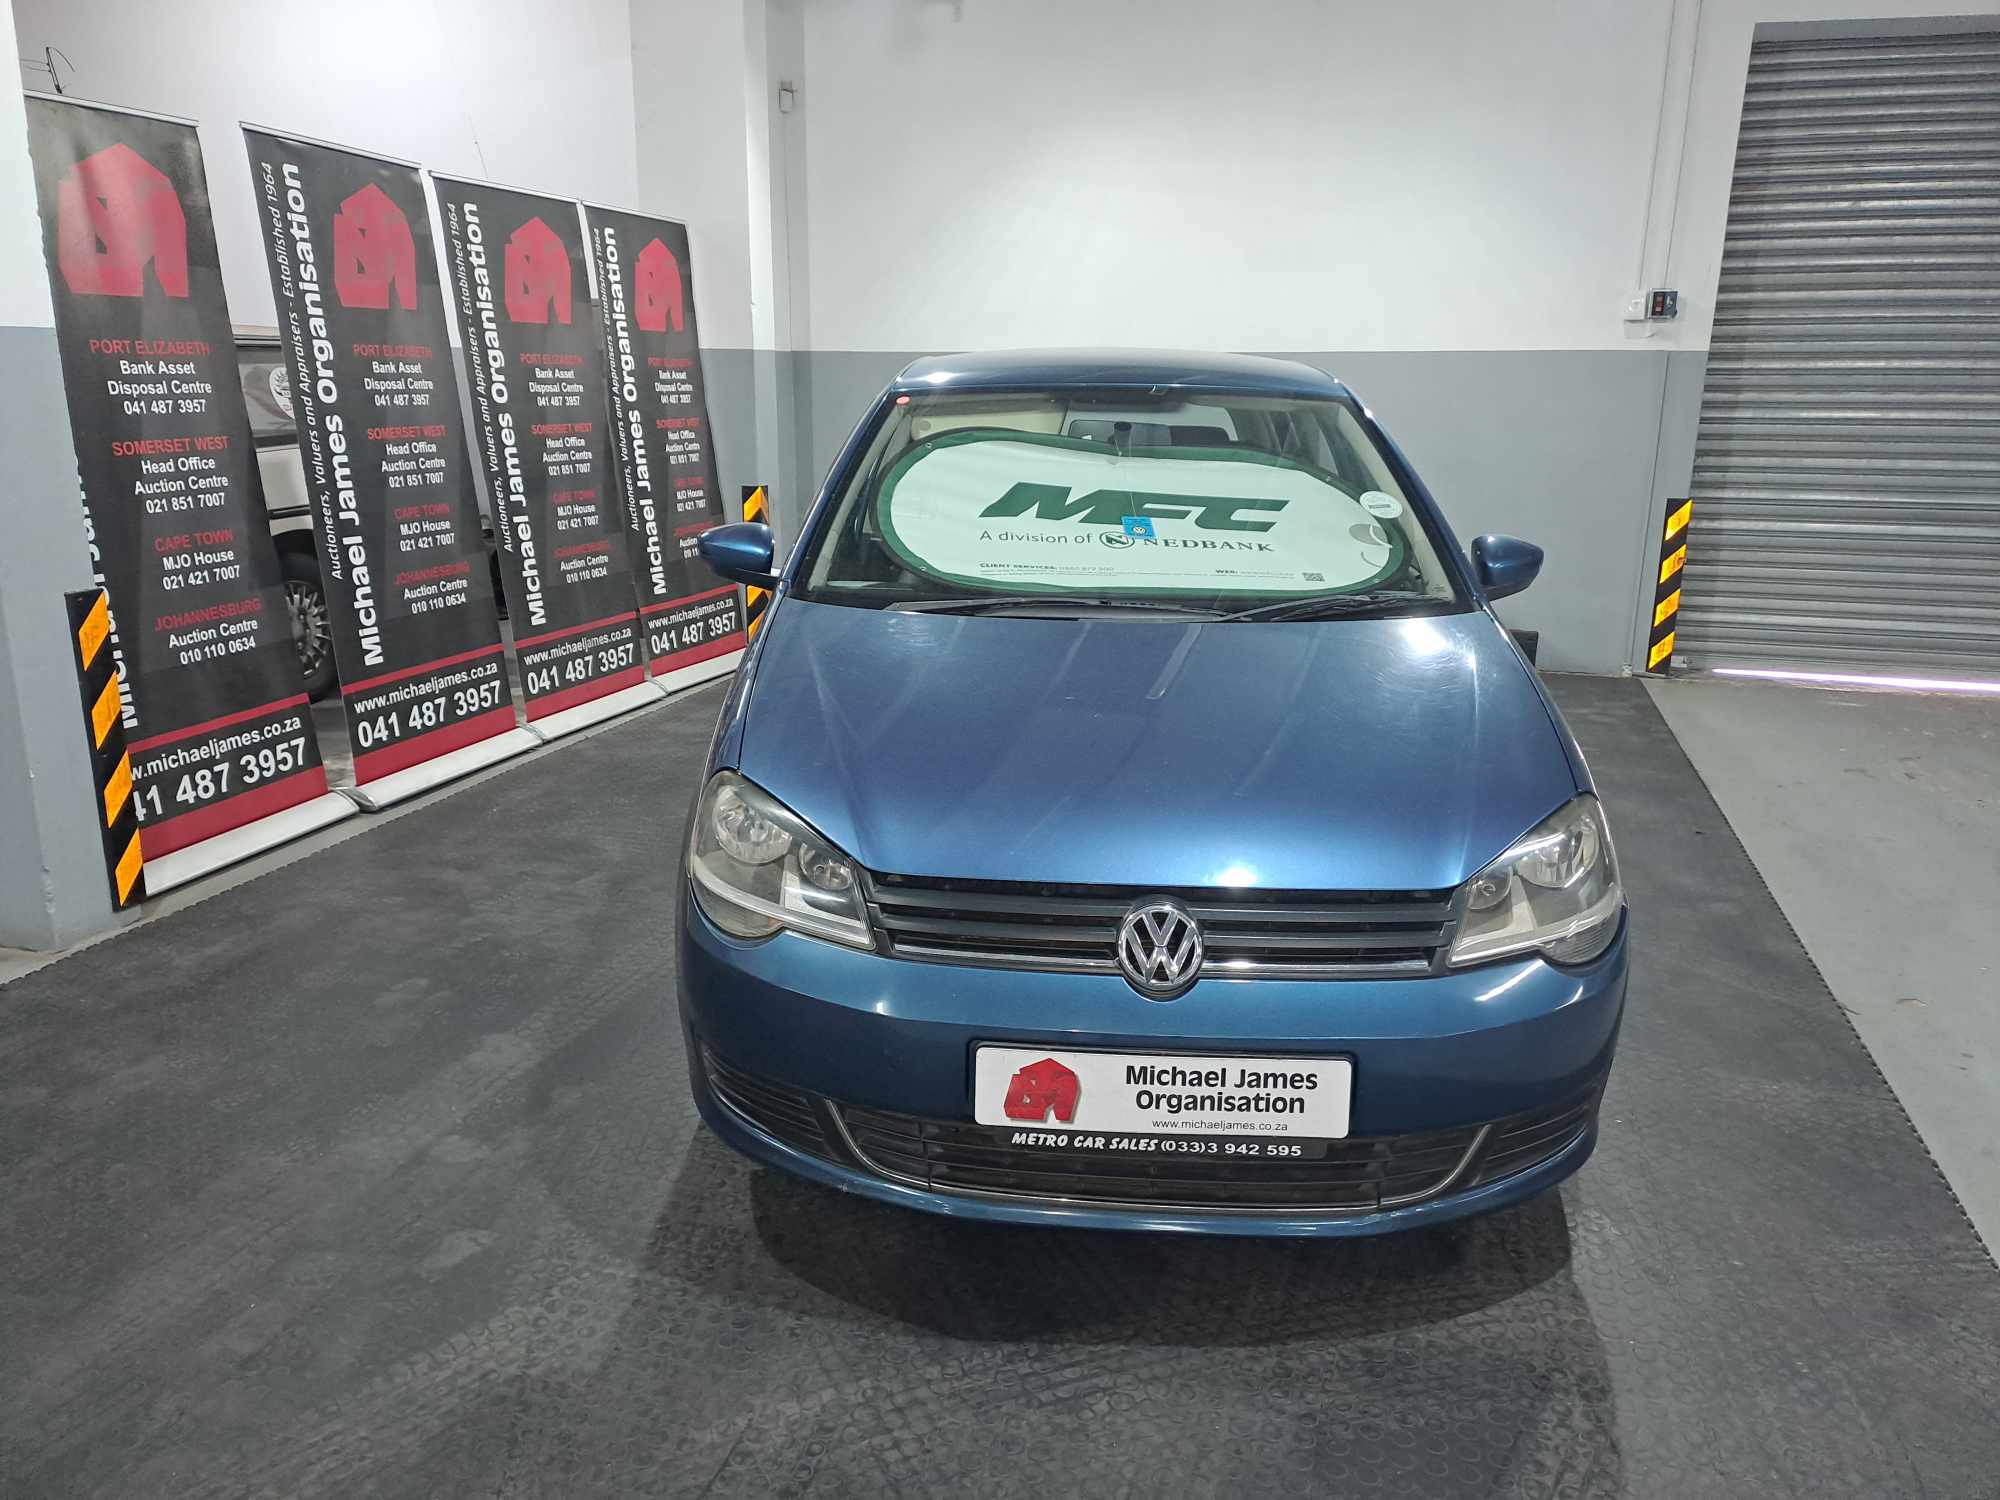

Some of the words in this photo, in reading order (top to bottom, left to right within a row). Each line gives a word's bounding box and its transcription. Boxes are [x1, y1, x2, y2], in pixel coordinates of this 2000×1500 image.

[261, 161, 279, 203] 1964
[447, 202, 461, 236] 1964
[268, 204, 295, 298] Established
[282, 163, 338, 404] Organisation
[453, 239, 473, 315] Established
[463, 202, 509, 404] Organisation
[604, 227, 638, 402] Organisation
[88, 339, 131, 355] PORT
[135, 340, 209, 357] ELIZABETH
[289, 311, 312, 393] Appraisers
[352, 343, 380, 357] PORT
[120, 360, 155, 375] Bank
[158, 361, 196, 375] Asset
[372, 361, 397, 374] Bank
[398, 361, 422, 374] Asset
[468, 326, 488, 396] Appraisers
[535, 367, 554, 379] Bank
[107, 380, 168, 397] Disposal
[171, 380, 212, 394] Centre
[364, 378, 405, 392] Disposal
[407, 378, 434, 390] Centre
[529, 382, 560, 394] Disposal
[123, 400, 147, 415] 041
[150, 400, 174, 414] 487
[178, 399, 206, 413] 3957
[300, 396, 316, 426] and
[374, 395, 391, 407] 041
[393, 394, 409, 406] 487
[411, 394, 429, 406] 3957
[480, 397, 492, 422] and
[536, 396, 550, 407] 041
[550, 396, 563, 406] 487
[112, 437, 191, 456] SOMERSET
[194, 435, 230, 450] WEST
[385, 443, 410, 456] Head
[411, 441, 437, 453] Office
[485, 425, 500, 472] Valuers
[546, 438, 563, 449] Head
[564, 437, 586, 447] Office
[628, 409, 651, 492] James
[141, 460, 175, 475] Head
[178, 457, 216, 471] Office
[306, 429, 327, 484] Valuers
[381, 460, 417, 473] Auction
[419, 457, 446, 469] Centre
[498, 412, 526, 507] James
[543, 452, 569, 463] Auction
[570, 450, 592, 461] Centre
[325, 414, 360, 526] James
[388, 476, 405, 488] 021
[407, 474, 423, 487] 851
[425, 472, 444, 484] 7007
[134, 479, 185, 495] Auction
[188, 475, 228, 490] Centre
[146, 498, 168, 514] 021
[171, 496, 194, 511] 851
[197, 492, 225, 508] 7007
[494, 476, 513, 552] Auctioneers,
[573, 504, 596, 514] House
[979, 480, 1291, 534] MFC
[320, 490, 344, 580] Auctioneers,
[400, 522, 421, 535] MJO
[422, 520, 451, 532] House
[570, 517, 582, 528] 421
[154, 535, 192, 552] CAPE
[194, 529, 234, 545] TOWN
[400, 540, 416, 552] 021
[418, 536, 434, 548] 421
[435, 533, 455, 546] 7007
[639, 498, 667, 596] Michael
[979, 530, 993, 541] A
[998, 530, 1069, 545] division
[1074, 532, 1093, 544] of
[1143, 537, 1277, 552] NEDBANK
[162, 555, 191, 571] MJO
[194, 550, 234, 566] House
[513, 514, 546, 626] Michael
[560, 559, 586, 571] Auction
[162, 575, 184, 590] 021
[188, 570, 210, 586] 421
[213, 565, 240, 582] 7007
[404, 585, 438, 600] Auction
[439, 578, 468, 592] Centre
[342, 535, 384, 666] Michael
[411, 601, 427, 614] 010
[428, 597, 444, 610] 110
[445, 593, 466, 607] 0634
[154, 598, 262, 632] JOHANNESBURG
[648, 598, 734, 630] www.michaeljames.co.za
[168, 628, 217, 649] Auction
[219, 618, 258, 637] Centre
[651, 629, 678, 654] 041
[681, 621, 704, 645] 487
[708, 611, 736, 637] 3957
[180, 650, 201, 665] 010
[204, 643, 226, 660] 110
[229, 636, 256, 653] 0634
[524, 627, 632, 666] www.michaeljames.co.za
[527, 665, 559, 695] 041
[565, 653, 594, 682] 487
[599, 643, 634, 673] 3957
[354, 660, 498, 715] www.michaeljames.co.za
[357, 712, 401, 748] 041
[408, 696, 447, 731] 487
[454, 680, 501, 717] 3957
[132, 716, 302, 781] w.michaeljames.co.za
[176, 762, 230, 804] 487
[240, 737, 306, 784] 3957
[1126, 1063, 1227, 1089] Michael
[1233, 1067, 1318, 1090] James
[1135, 1089, 1305, 1115] Organisation
[1151, 1118, 1288, 1133] www.michaeljames.co.za
[1011, 1133, 1068, 1148] METRO
[1073, 1135, 1106, 1149] CAR
[1108, 1137, 1157, 1152] SALES
[1160, 1140, 1218, 1155] (033)3
[1224, 1142, 1261, 1156] 942
[1266, 1144, 1302, 1157] 595
